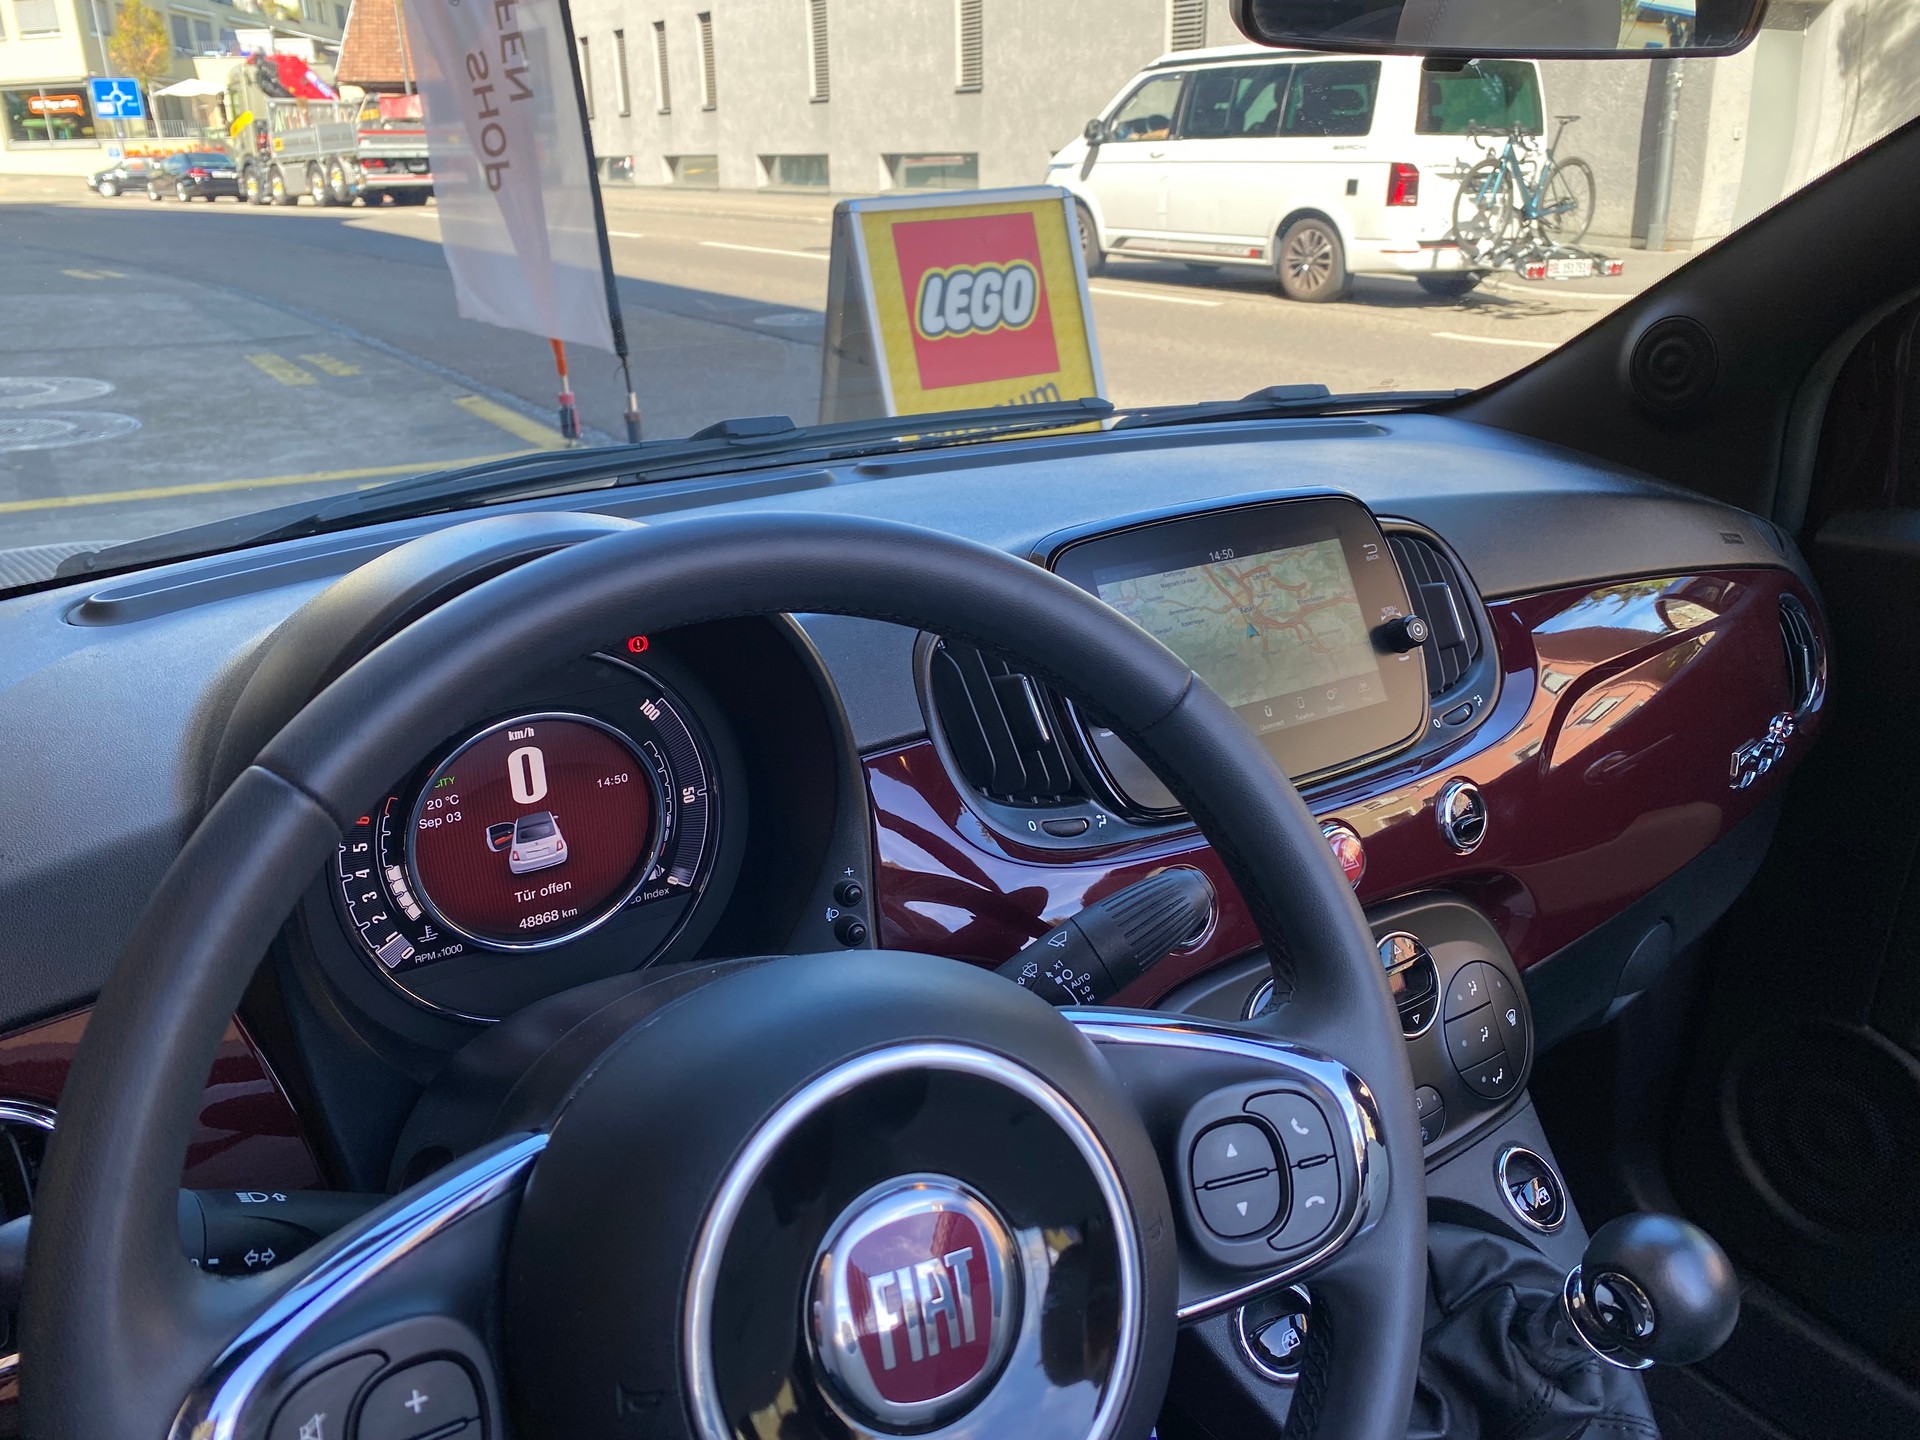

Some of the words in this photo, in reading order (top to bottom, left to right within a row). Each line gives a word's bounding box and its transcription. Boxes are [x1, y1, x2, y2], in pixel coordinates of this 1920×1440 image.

[919, 265, 1037, 336] LEGO
[1208, 548, 1234, 561] 14:50
[1366, 554, 1380, 562] BACK
[639, 699, 661, 721] 100
[508, 726, 535, 741] km/h
[507, 746, 548, 804] 0
[597, 773, 629, 788] 14:50
[426, 798, 443, 811] 20
[444, 794, 460, 806] °C
[682, 786, 696, 804] 50
[418, 816, 443, 830] Sep
[446, 811, 462, 823] 03
[352, 842, 368, 852] 5
[355, 868, 370, 879] 4
[361, 891, 378, 903] 3
[514, 889, 536, 903] Tür
[540, 880, 572, 897] offen
[643, 887, 670, 901] Index
[372, 911, 387, 924] 2
[518, 909, 559, 930] 48868
[561, 906, 578, 919] km
[385, 931, 398, 943] 1
[401, 946, 415, 960] 0
[414, 951, 436, 964] RPM
[437, 943, 463, 958] x1000
[1070, 972, 1091, 989] AUTO
[1080, 985, 1091, 996] LO
[1086, 994, 1095, 1002] HI
[868, 1246, 976, 1371] FIAT
